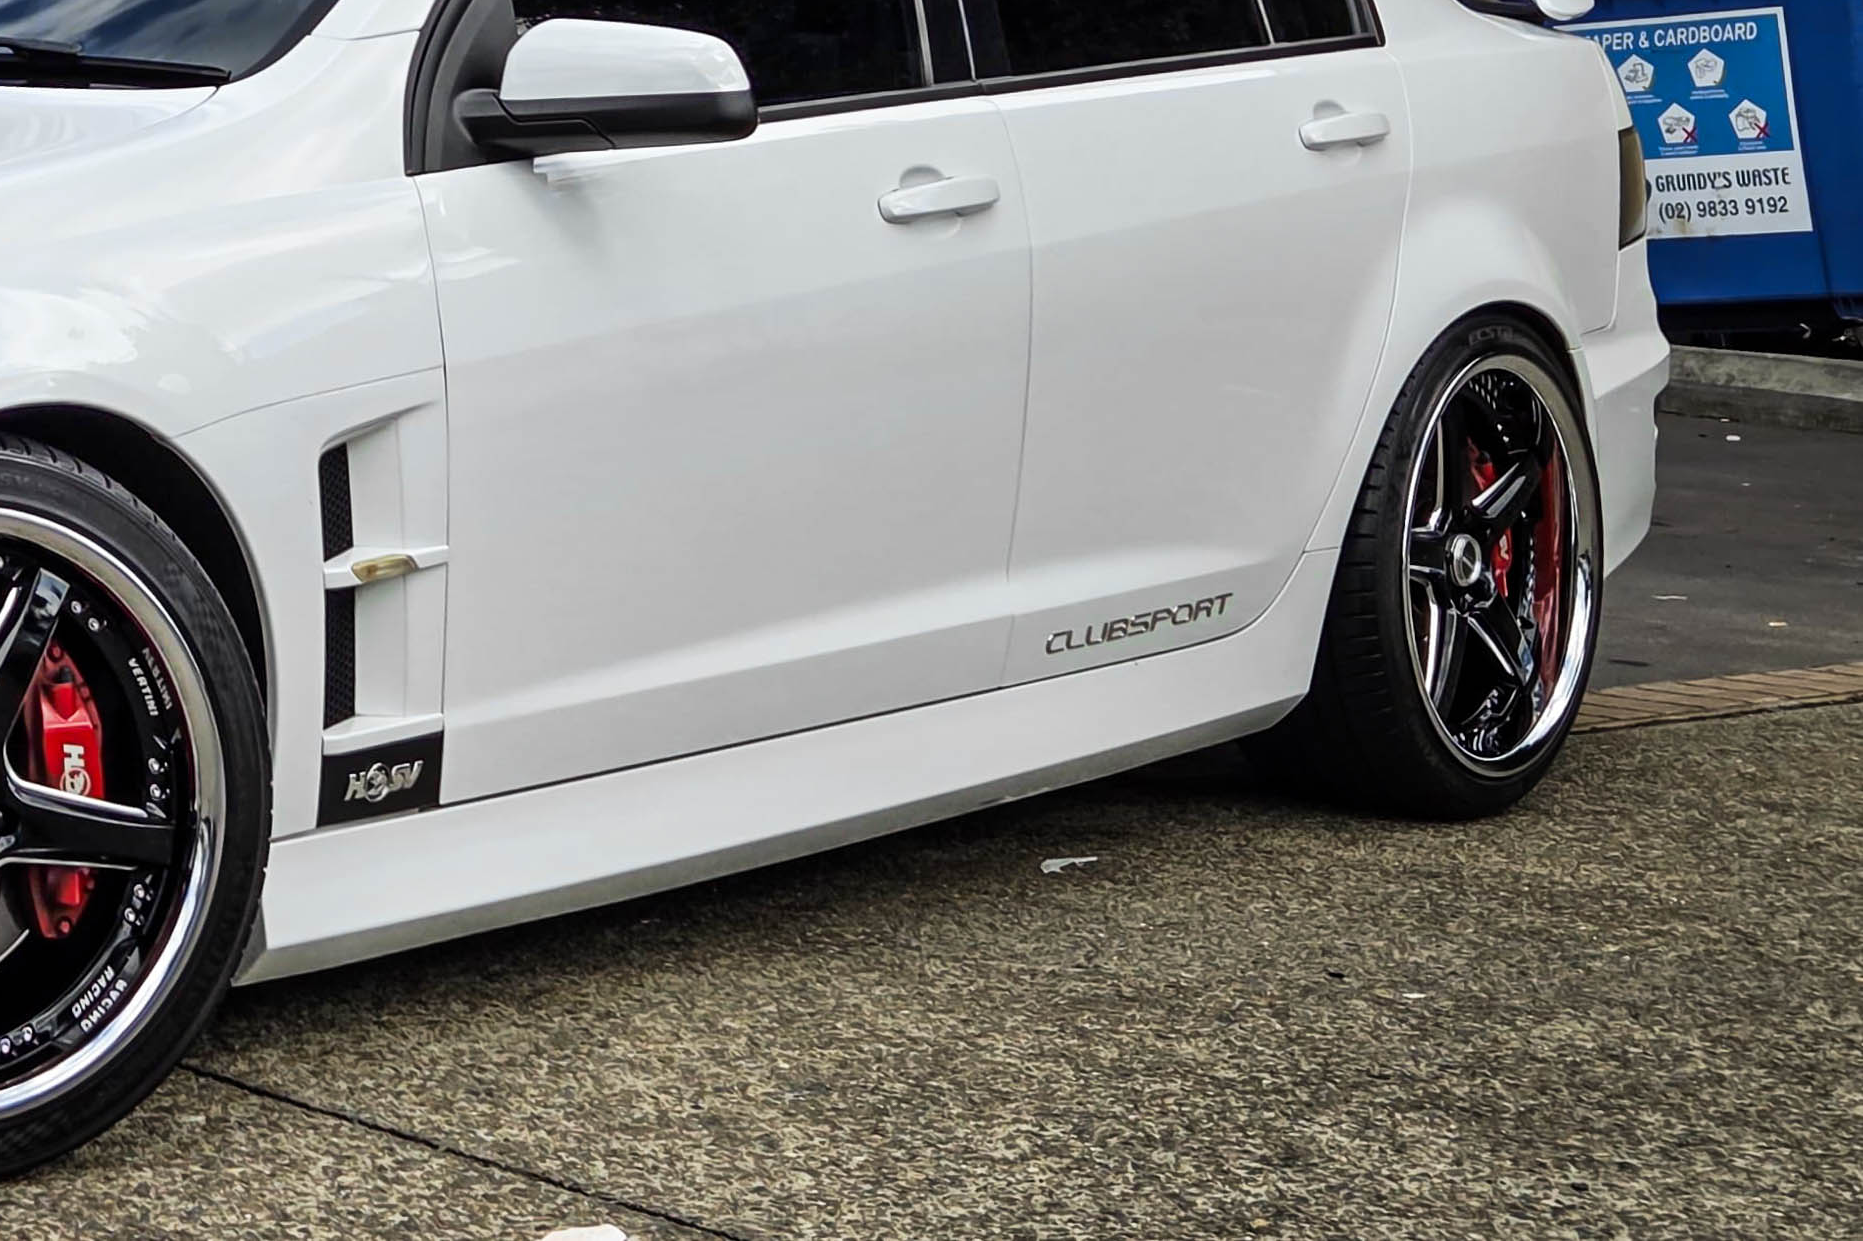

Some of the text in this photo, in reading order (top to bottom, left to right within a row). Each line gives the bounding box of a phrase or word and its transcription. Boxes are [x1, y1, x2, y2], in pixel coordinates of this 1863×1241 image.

[1586, 21, 1758, 52] APER & CARDBOARD
[1655, 166, 1792, 193] GRUNDY'S WASTE
[1658, 195, 1790, 223] (02) 9833 9192
[1045, 592, 1234, 654] CLUBSPORT
[127, 657, 159, 716] VERTINI
